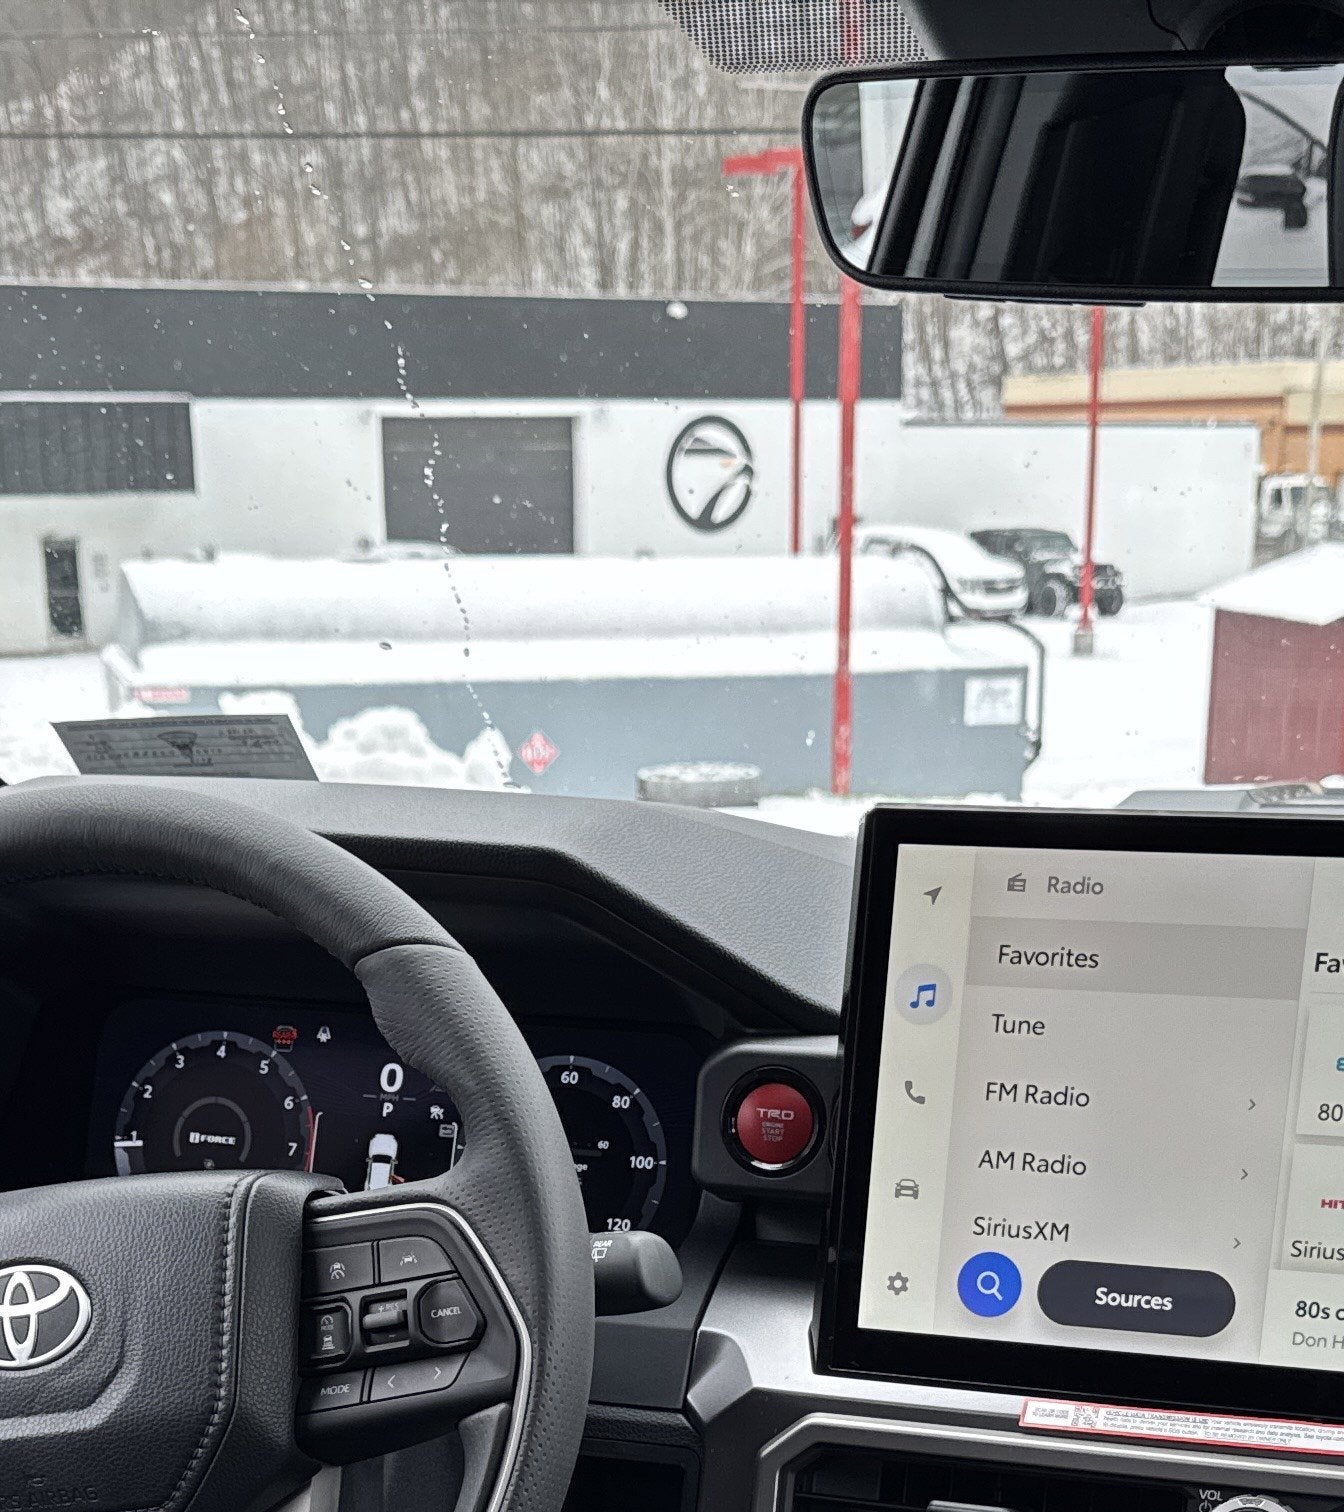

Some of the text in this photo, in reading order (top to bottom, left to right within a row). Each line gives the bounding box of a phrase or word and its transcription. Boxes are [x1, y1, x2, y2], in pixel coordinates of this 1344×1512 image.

[1046, 875, 1104, 896] Radio
[997, 944, 1100, 969] Favorites
[991, 1013, 1046, 1036] Tune
[216, 1045, 226, 1059] 4
[175, 1055, 185, 1069] 3
[259, 1060, 269, 1074] 5
[380, 1062, 404, 1093] 0
[560, 1071, 579, 1085] 60
[142, 1085, 153, 1099] 2
[985, 1081, 1091, 1108] FM Radio
[284, 1096, 294, 1110] 6
[611, 1095, 630, 1109] 80
[382, 1102, 394, 1117] P
[756, 1107, 795, 1120] TRD
[130, 1130, 138, 1142] 1
[288, 1142, 298, 1157] 7
[597, 1140, 609, 1150] 60
[629, 1156, 654, 1170] 100
[978, 1149, 1087, 1177] AM Radio
[606, 1218, 631, 1232] 120
[971, 1216, 1070, 1243] SiriusXM
[1094, 1286, 1173, 1311] Sources
[430, 1306, 462, 1319] CANCEL
[1294, 1301, 1331, 1321] 80s
[1292, 1331, 1327, 1350] Don
[320, 1383, 351, 1397] MODE
[1199, 1488, 1223, 1501] VOL
